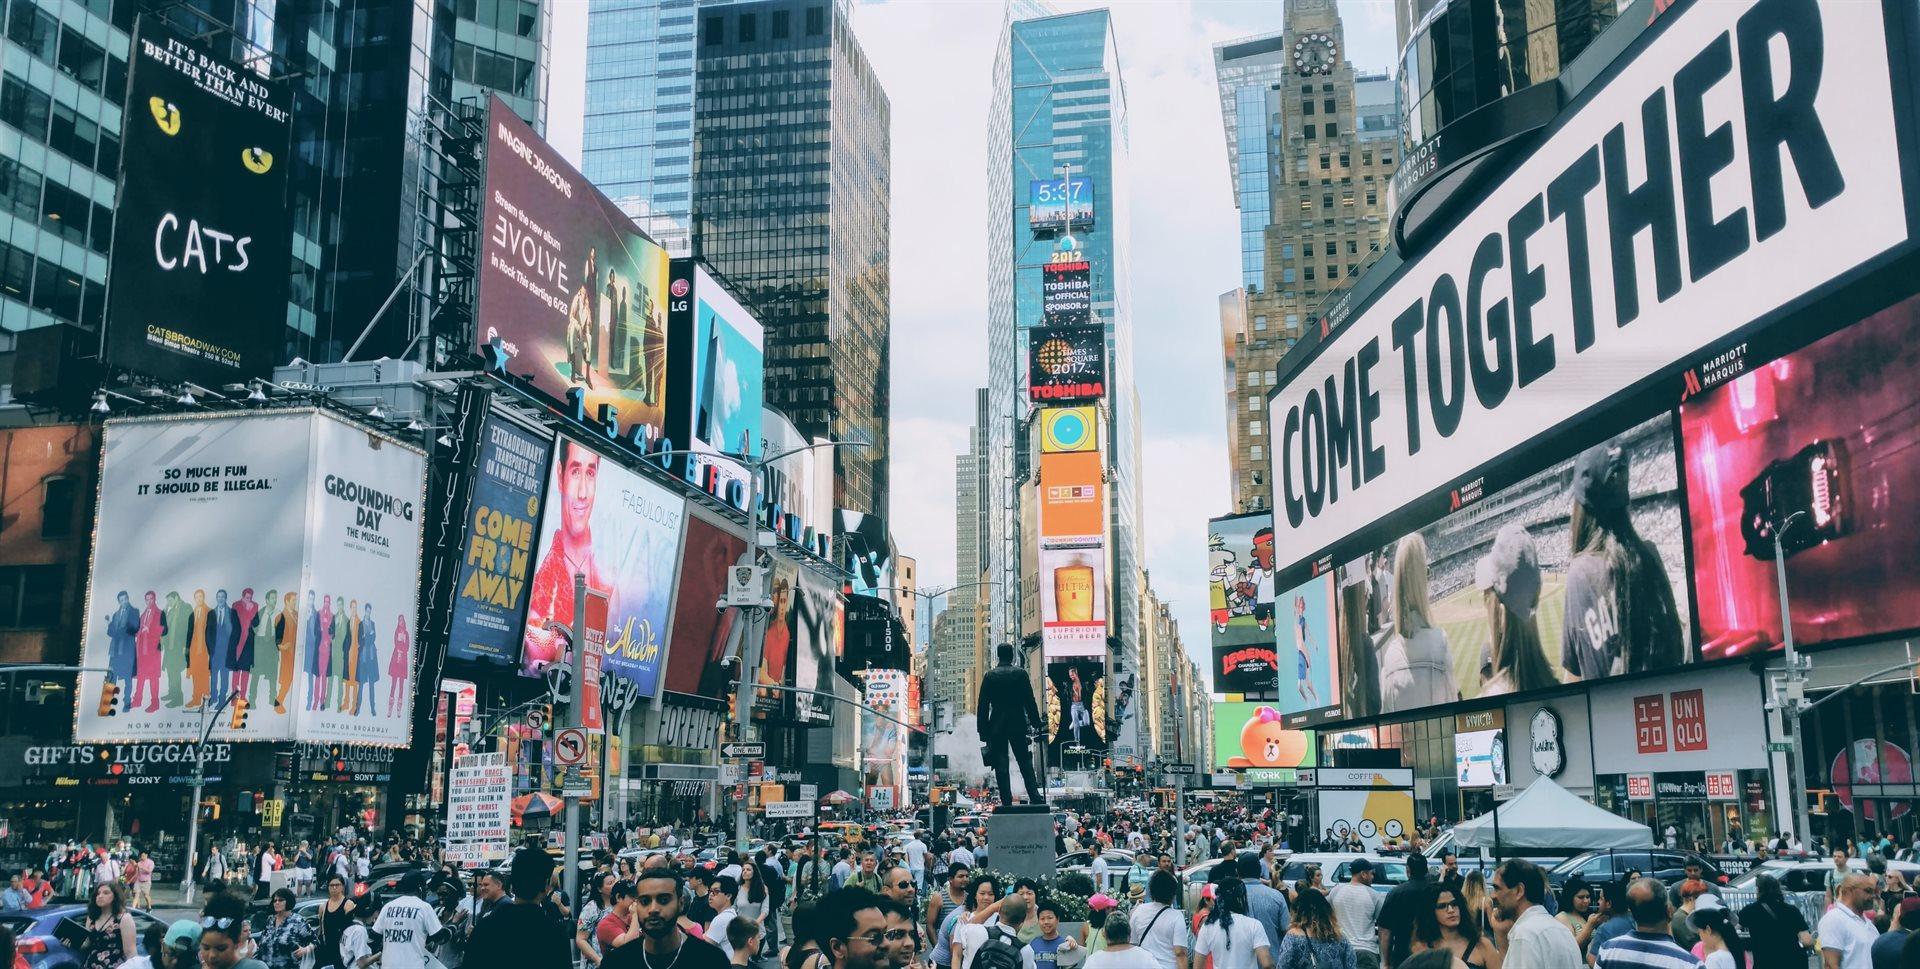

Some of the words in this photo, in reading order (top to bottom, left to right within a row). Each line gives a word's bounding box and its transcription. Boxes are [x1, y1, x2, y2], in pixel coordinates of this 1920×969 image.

[167, 37, 196, 62] IT'S
[199, 54, 236, 83] BACK
[239, 77, 269, 99] AND
[204, 72, 245, 102] THAN
[498, 122, 533, 165] IMAGINE
[532, 153, 572, 199] DRAGONS
[1397, 135, 1441, 182] MARRIOTT
[1398, 156, 1436, 198] MARQUIS
[1038, 182, 1084, 202] 5:37
[494, 190, 517, 217] Stream
[518, 209, 529, 225] the
[529, 220, 542, 236] new
[543, 230, 561, 251] album
[155, 213, 251, 274] CATS
[492, 215, 570, 295] EVOLVE
[1043, 262, 1089, 272] TOSHIBA
[1282, 335, 1386, 529] COME
[1392, 0, 1846, 457] TOGETHER
[491, 252, 499, 268] in
[499, 258, 516, 279] Rock
[516, 270, 529, 288] This
[529, 282, 553, 307] starting
[553, 296, 568, 316] 6/23
[1044, 280, 1089, 291] TOSHIBA
[1055, 291, 1090, 300] OFFICIAL
[671, 300, 688, 312] LG
[1045, 302, 1082, 311] SPONSOR
[147, 324, 241, 362] CATSBROADWAY.COM
[1062, 348, 1087, 356] TIMES
[1065, 355, 1099, 363] SQUARE
[1702, 343, 1748, 374] MARRIOTT
[1052, 362, 1086, 374] 2017
[1704, 360, 1744, 386] MARQUIS
[282, 381, 330, 392] LAMAR
[1030, 382, 1104, 398] TOSHIBA
[495, 446, 528, 474] TRANSPORTS
[529, 462, 536, 477] US
[186, 466, 220, 479] MUCH
[224, 465, 248, 477] FUN
[485, 459, 495, 475] ON
[494, 463, 500, 478] A
[500, 465, 517, 485] WAVE
[516, 472, 525, 487] OF
[137, 484, 150, 496] IT
[154, 482, 200, 495] SHOULD
[203, 481, 219, 492] BE
[1461, 476, 1485, 494] MARRIOTT
[324, 474, 413, 522] GROUNDHOG
[1461, 487, 1482, 504] MARQUIS
[356, 506, 382, 532] DAY
[475, 505, 533, 551] COME
[346, 526, 360, 539] THE
[361, 530, 390, 548] MUSICAL
[467, 534, 529, 581] FROM
[461, 568, 524, 610] AWAY
[1058, 583, 1091, 592] ULTRA
[605, 615, 658, 664] Aladdin
[1674, 697, 1700, 720] UNI
[127, 722, 151, 730] NOW
[158, 721, 172, 729] ON
[657, 702, 721, 749] FOREVER
[1465, 711, 1494, 728] INVICTA
[353, 724, 389, 734] BROADWAY
[1676, 722, 1703, 748] QLO
[24, 745, 95, 765] GIFTS
[114, 744, 231, 764] LUGGAGE
[340, 743, 395, 763] LUGGAGE
[733, 746, 746, 754] ONE
[460, 755, 479, 768] WORD
[480, 755, 488, 766] OF
[490, 753, 504, 766] GOD
[122, 764, 144, 775] NY
[312, 772, 329, 781] Nikon
[354, 773, 374, 781] SONY
[456, 770, 469, 778] ONLY
[1256, 771, 1281, 779] YORK
[1347, 772, 1383, 780] COFFEED
[54, 776, 80, 786] Nikon
[128, 776, 161, 785] SONY
[1721, 776, 1732, 784] UNI
[478, 786, 485, 794] BE
[487, 785, 506, 793] SAVED
[672, 780, 698, 796] FOREVER
[1657, 782, 1682, 793] LifeWear
[1684, 782, 1706, 795] Pop-Up
[450, 795, 476, 803] THROUGH
[496, 794, 503, 802] IN
[263, 801, 272, 822] ATM
[477, 803, 499, 811] CHRIST
[455, 812, 466, 820] NOT
[468, 812, 475, 820] BY
[478, 811, 500, 819] WORKS
[488, 820, 502, 828] MAN
[448, 830, 460, 838] CAN
[446, 843, 468, 852] JESUS
[477, 843, 491, 852] THE
[492, 843, 507, 851] ONLY
[446, 852, 461, 860] WAY
[463, 851, 474, 860] TO
[386, 906, 420, 920] REPENT
[384, 928, 413, 943] PERISH
